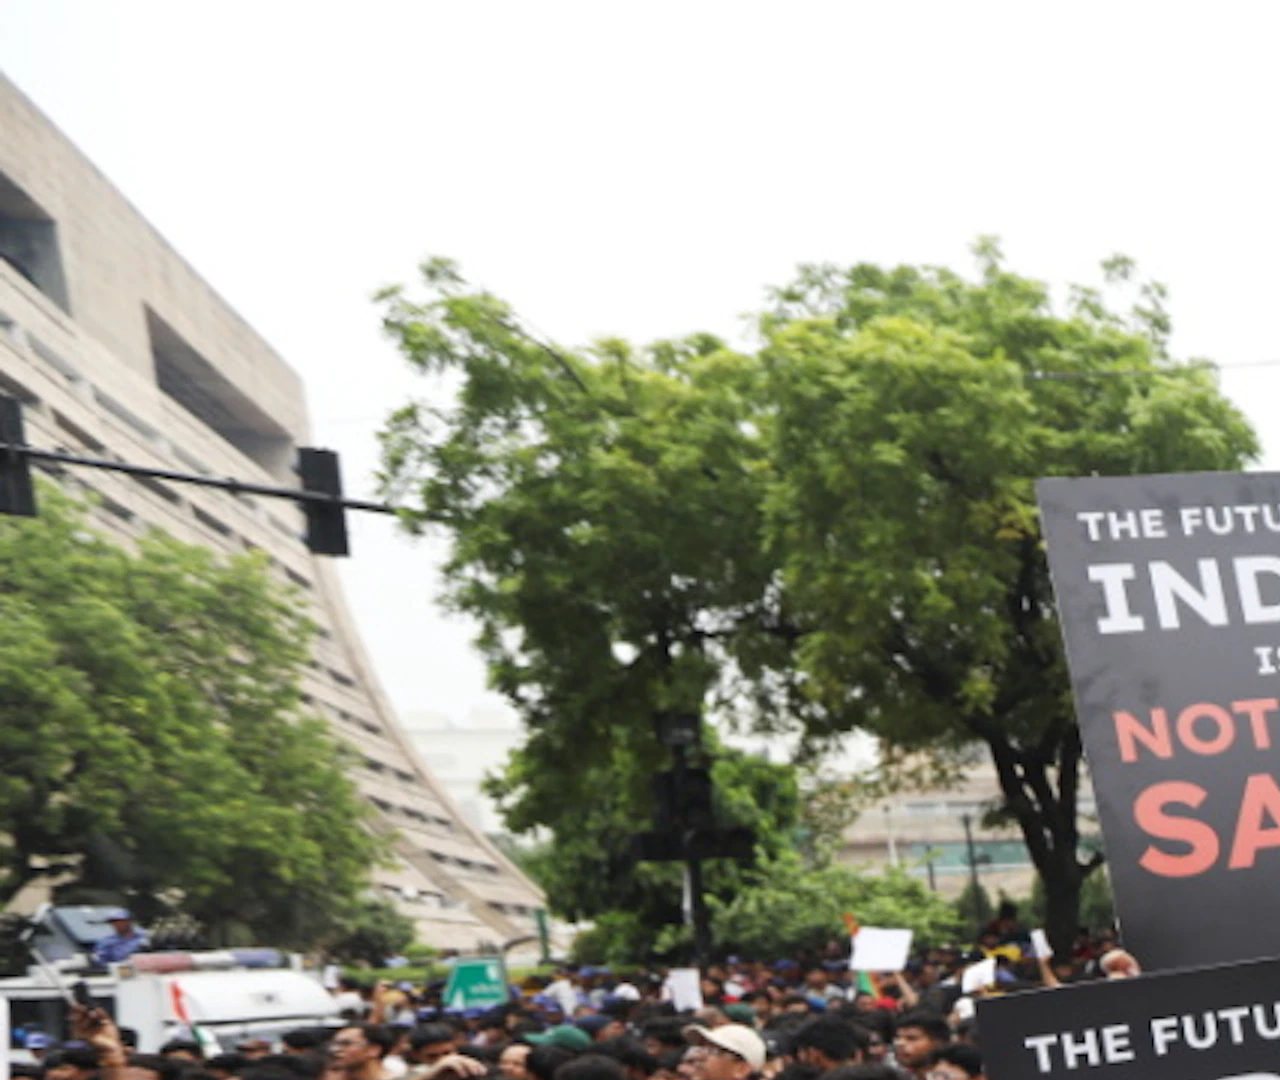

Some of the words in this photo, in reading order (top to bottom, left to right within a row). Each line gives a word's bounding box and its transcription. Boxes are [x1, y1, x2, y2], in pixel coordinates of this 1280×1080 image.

[1076, 508, 1169, 542] THE
[1112, 697, 1280, 763] NOT
[1024, 1024, 1135, 1073] THE
